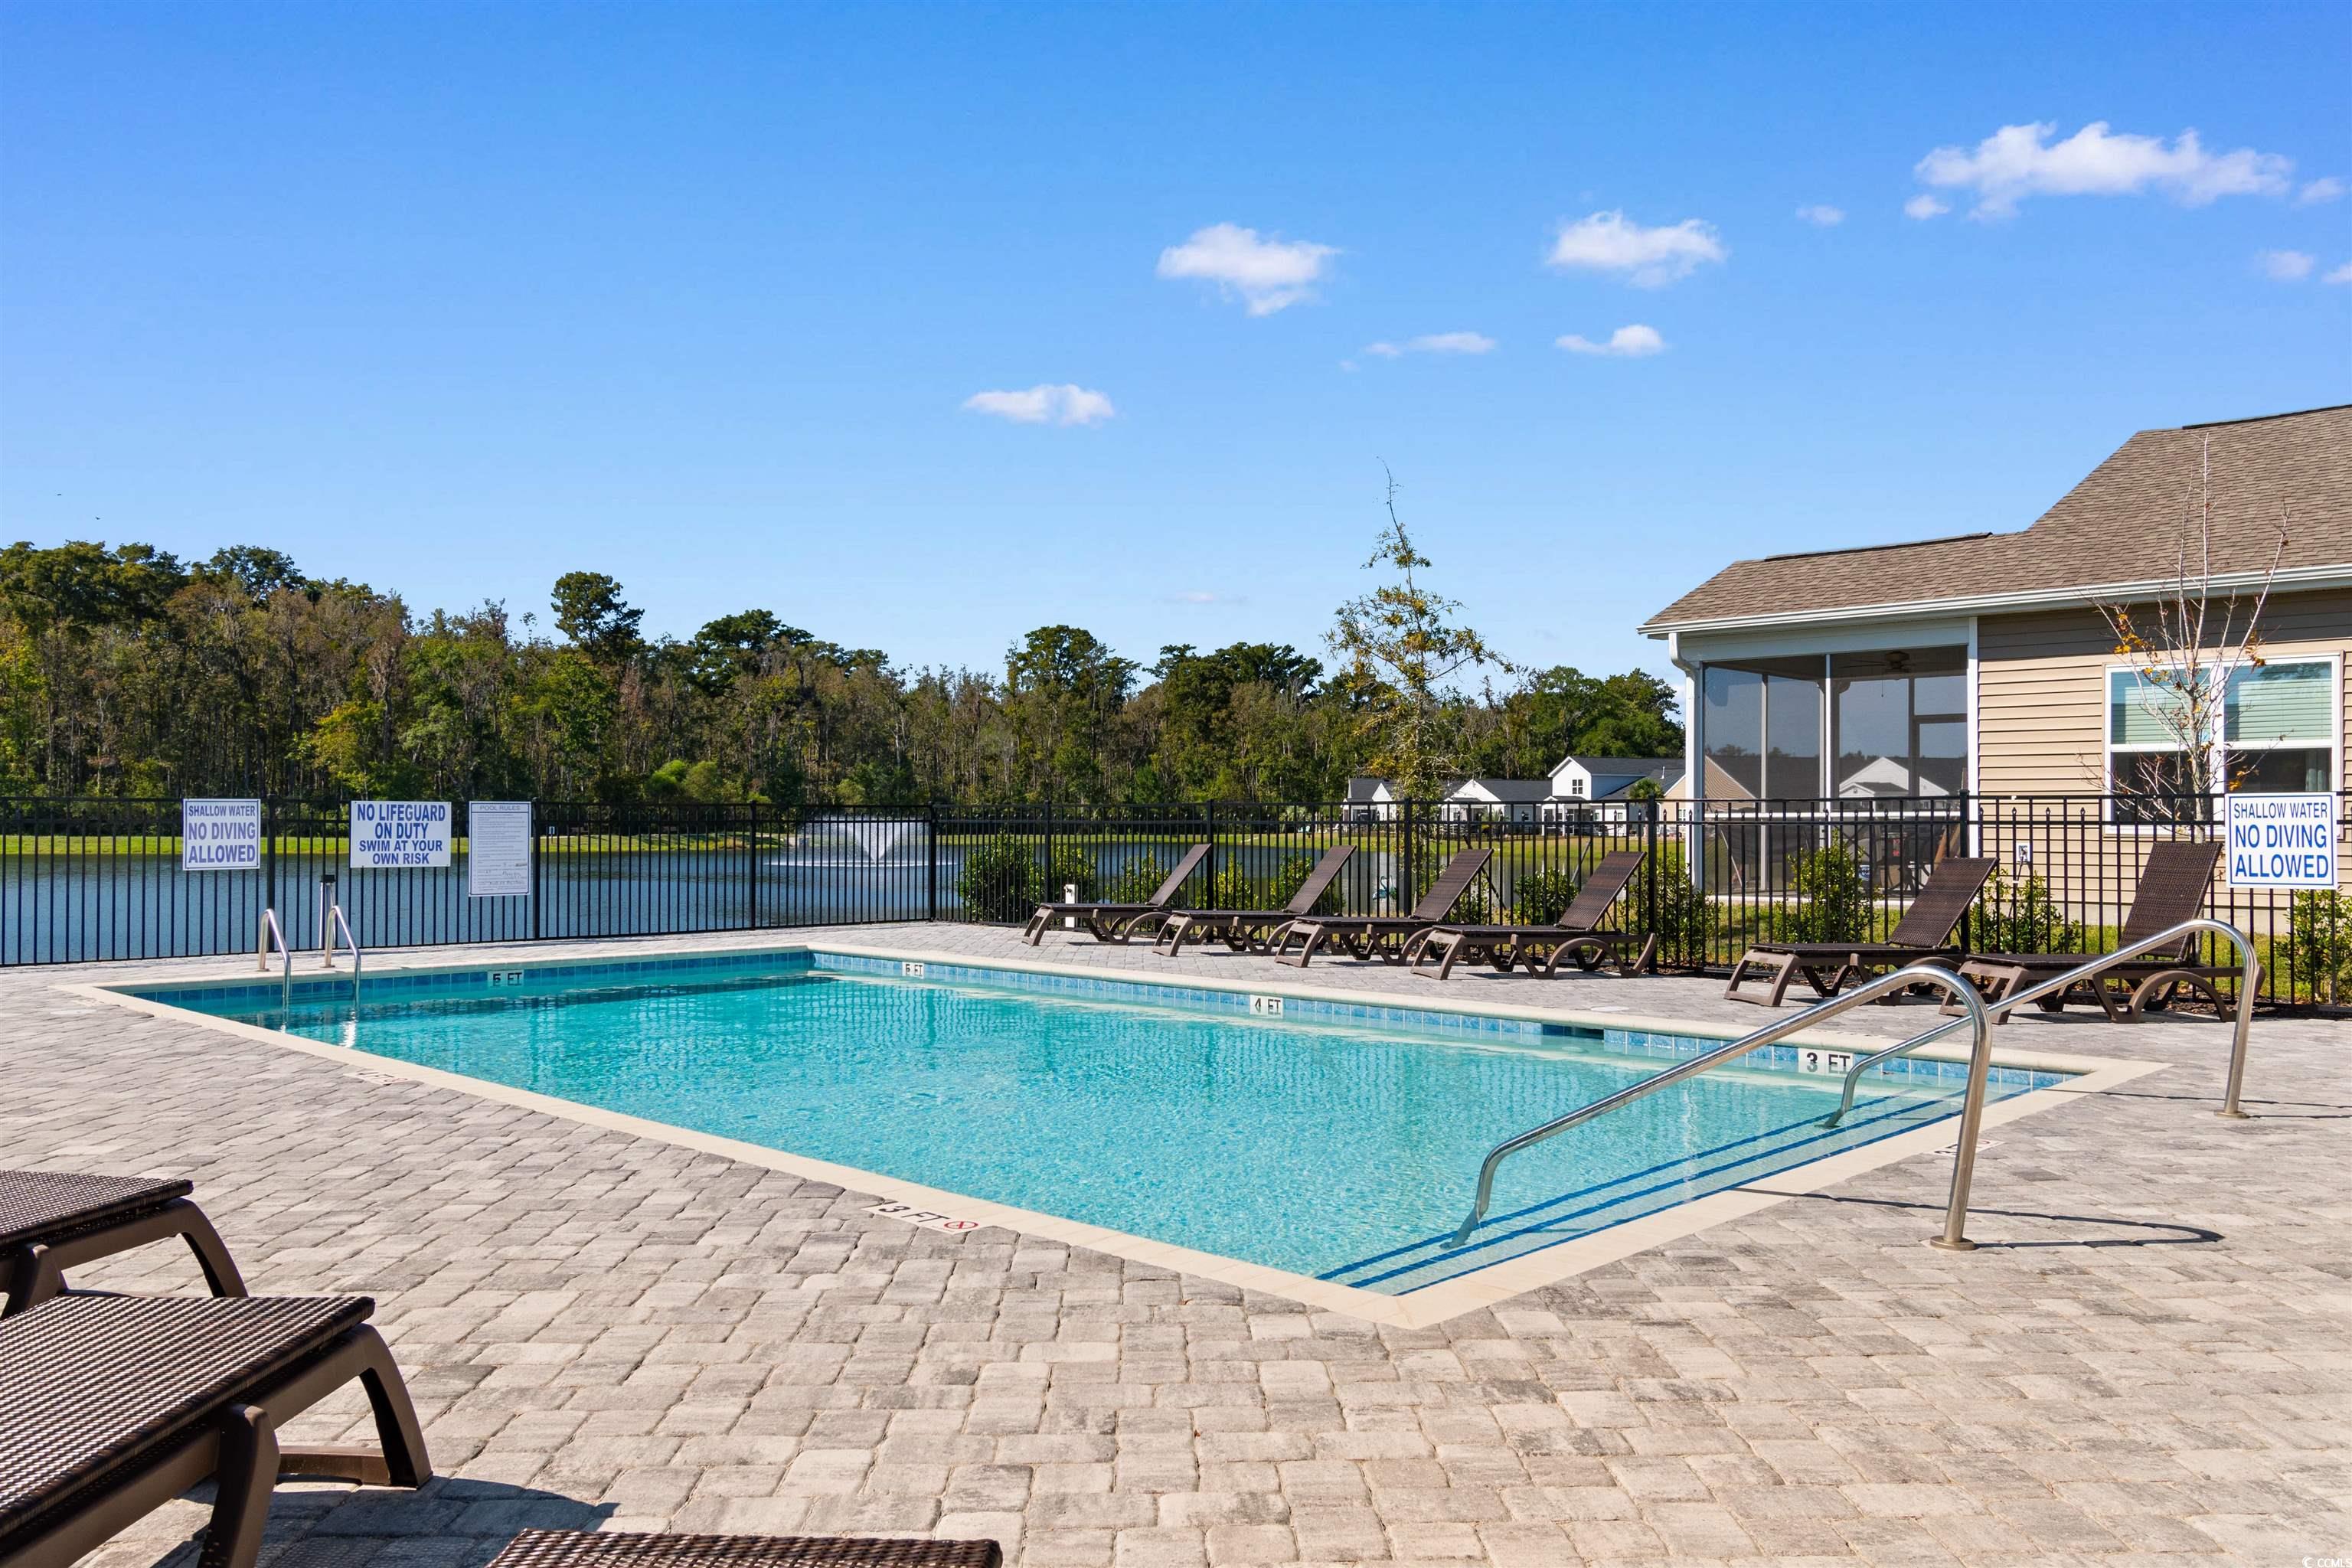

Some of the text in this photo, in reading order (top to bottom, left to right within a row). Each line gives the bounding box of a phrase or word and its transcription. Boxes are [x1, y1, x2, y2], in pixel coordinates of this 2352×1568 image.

[188, 805, 256, 816] SHALLOW WATER
[358, 804, 446, 822] NO LIFEGUARD
[2233, 802, 2328, 818] SHALLOW WATER
[188, 822, 256, 840] NO DIVING
[375, 822, 429, 839] ON DUTY
[2236, 824, 2327, 848] NO DIVING
[188, 844, 256, 863] ALLOWED
[359, 840, 443, 851] SWIM AT YOUR
[372, 853, 430, 864] OWN RISK
[2235, 854, 2329, 878] ALLOWED
